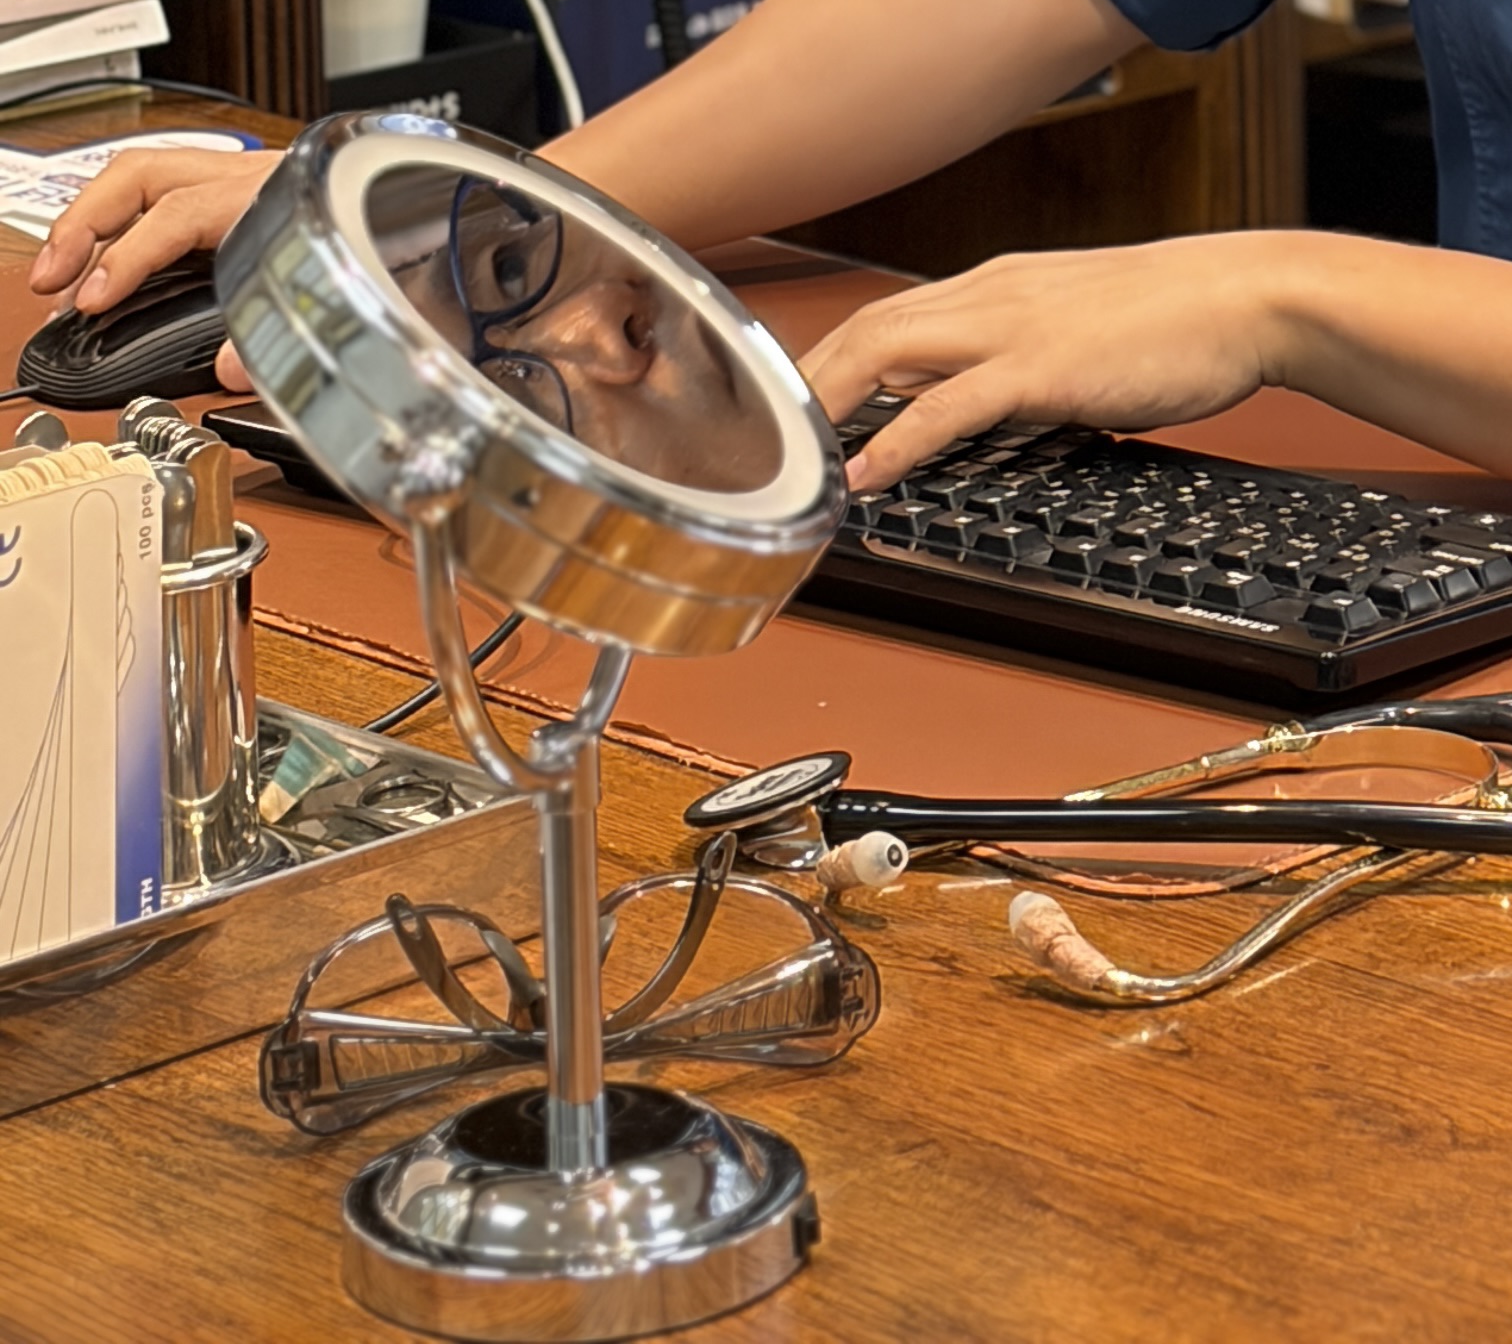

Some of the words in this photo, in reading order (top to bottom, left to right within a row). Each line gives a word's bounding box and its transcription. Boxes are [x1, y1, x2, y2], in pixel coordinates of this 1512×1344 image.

[140, 482, 155, 519] pcs
[138, 525, 153, 560] 100
[1175, 606, 1281, 633] SAMSUNG
